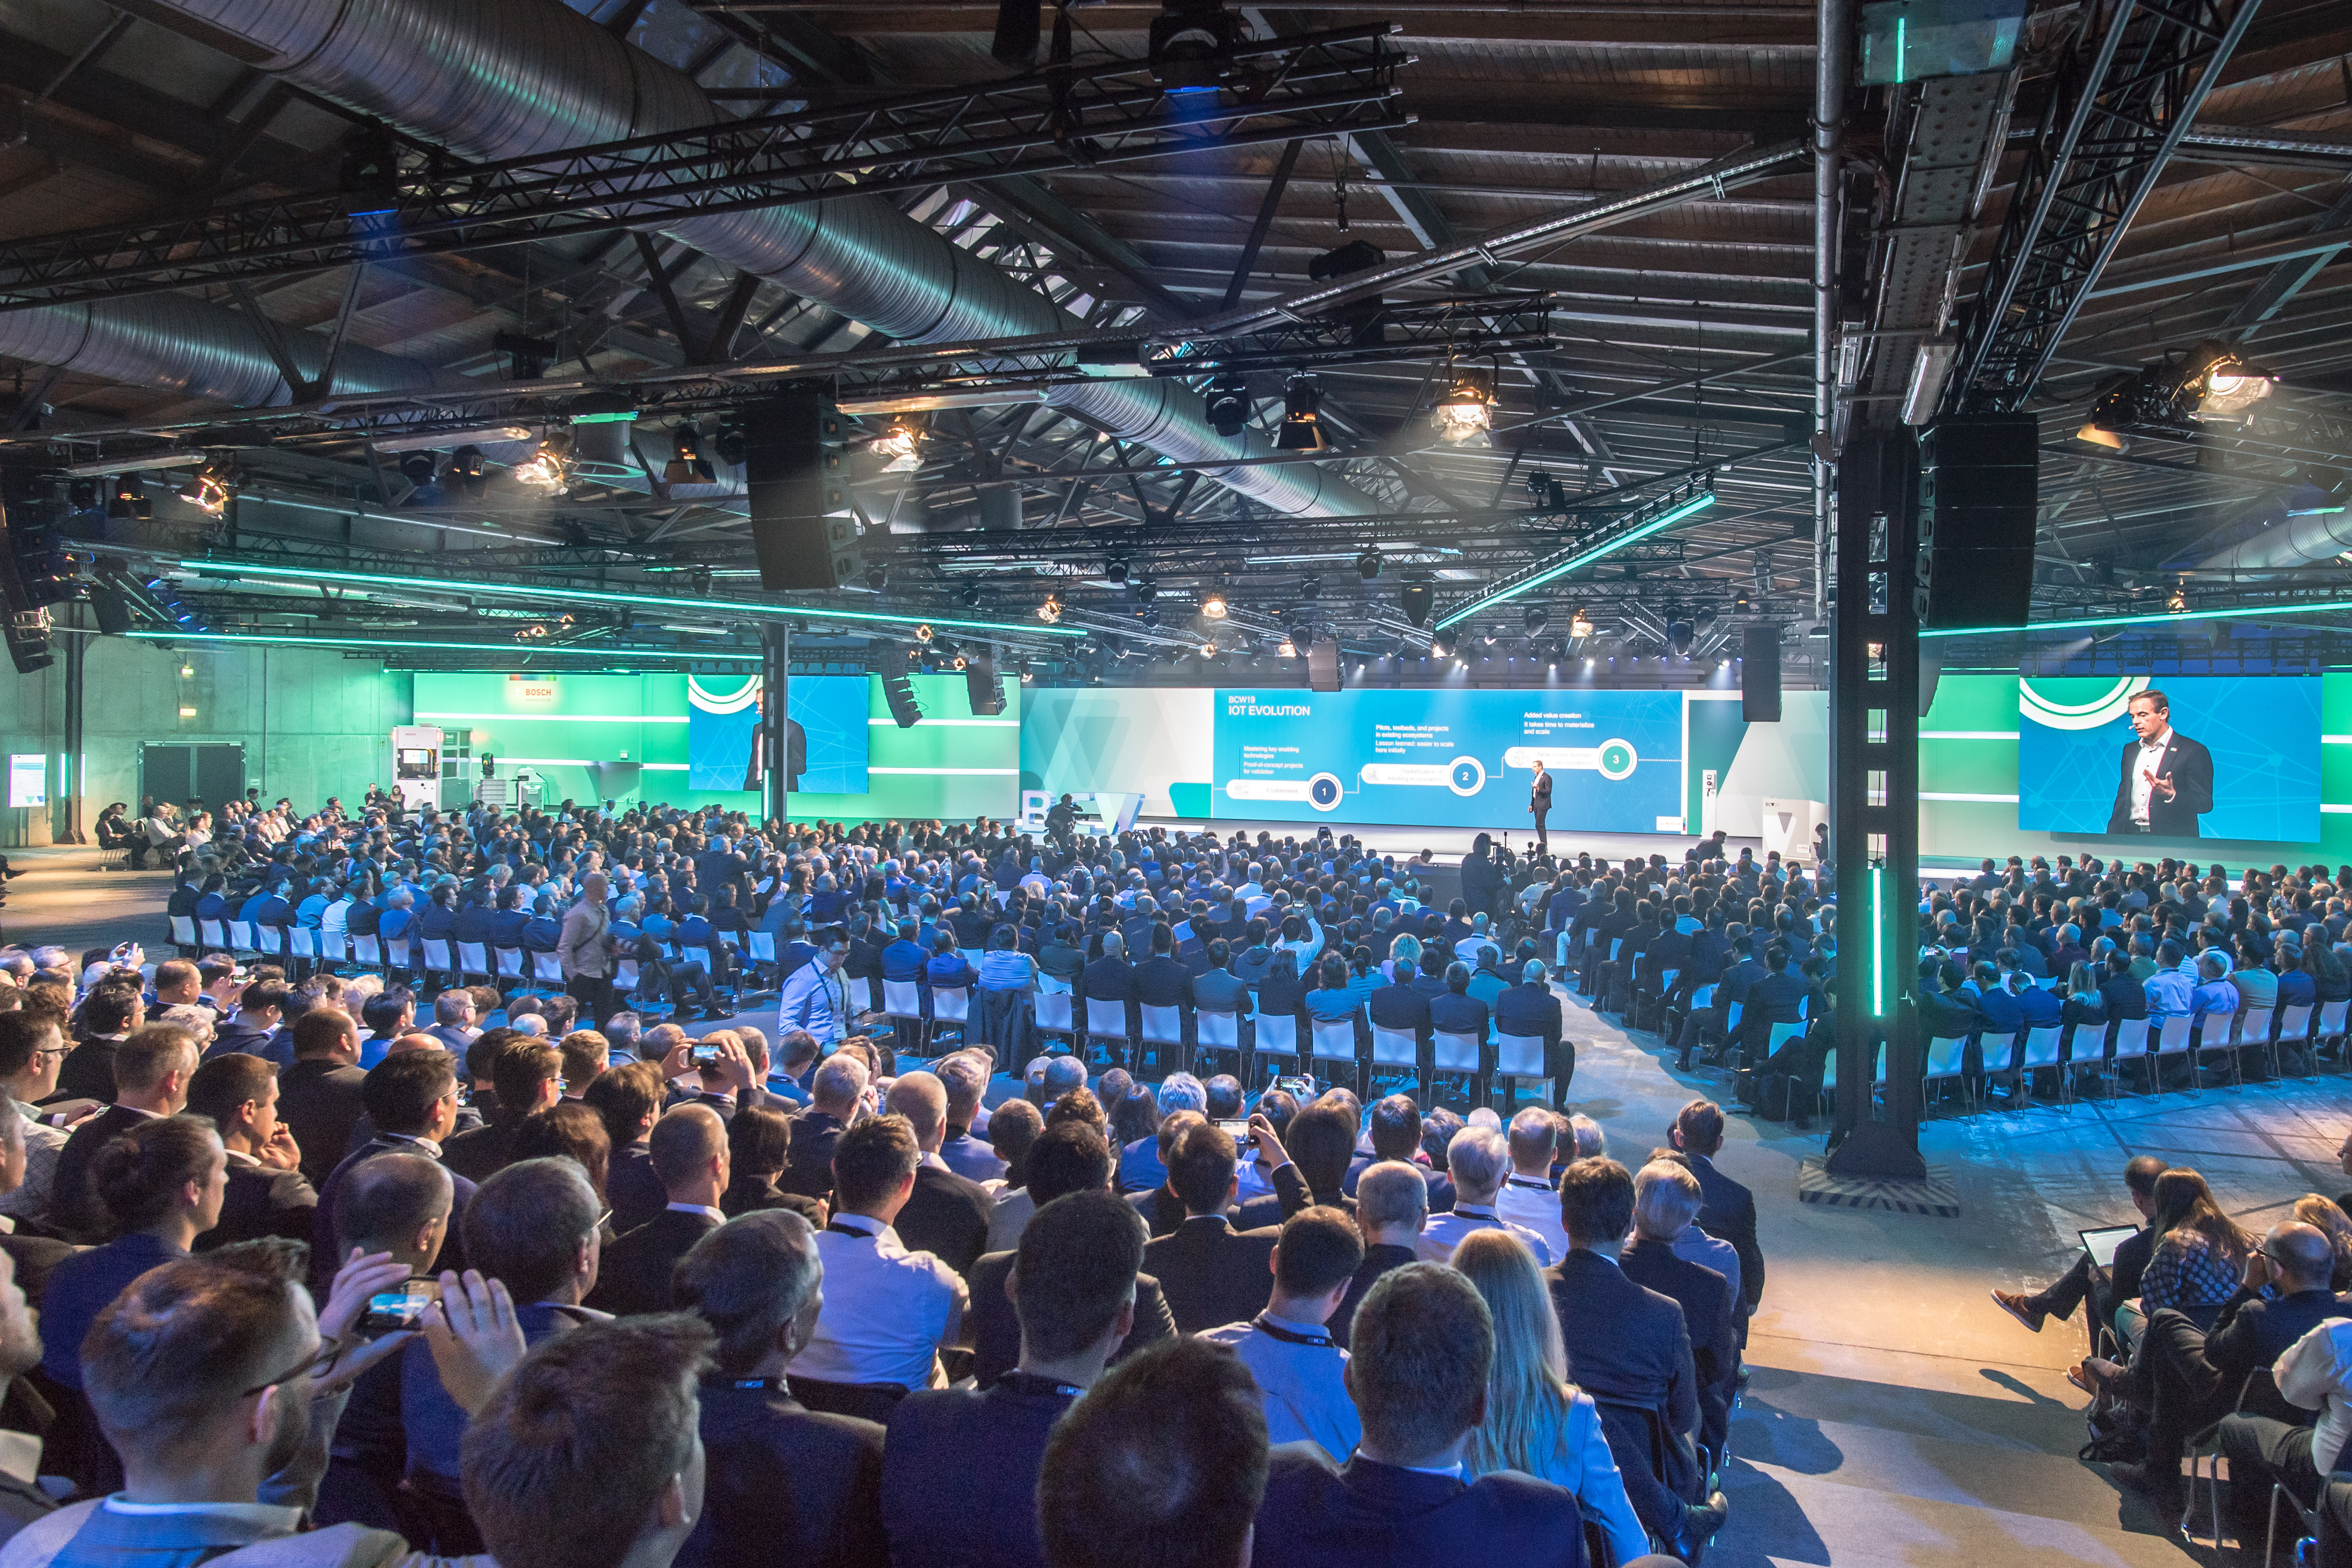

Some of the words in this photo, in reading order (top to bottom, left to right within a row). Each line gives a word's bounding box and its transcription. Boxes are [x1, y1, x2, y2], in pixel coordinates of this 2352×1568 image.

[1228, 695, 1256, 703] BCW19
[1229, 706, 1247, 715] IOT
[1248, 706, 1311, 716] EVOLUTION
[1613, 755, 1619, 764] 3
[1462, 772, 1469, 781] 2
[1322, 787, 1326, 796] 1
